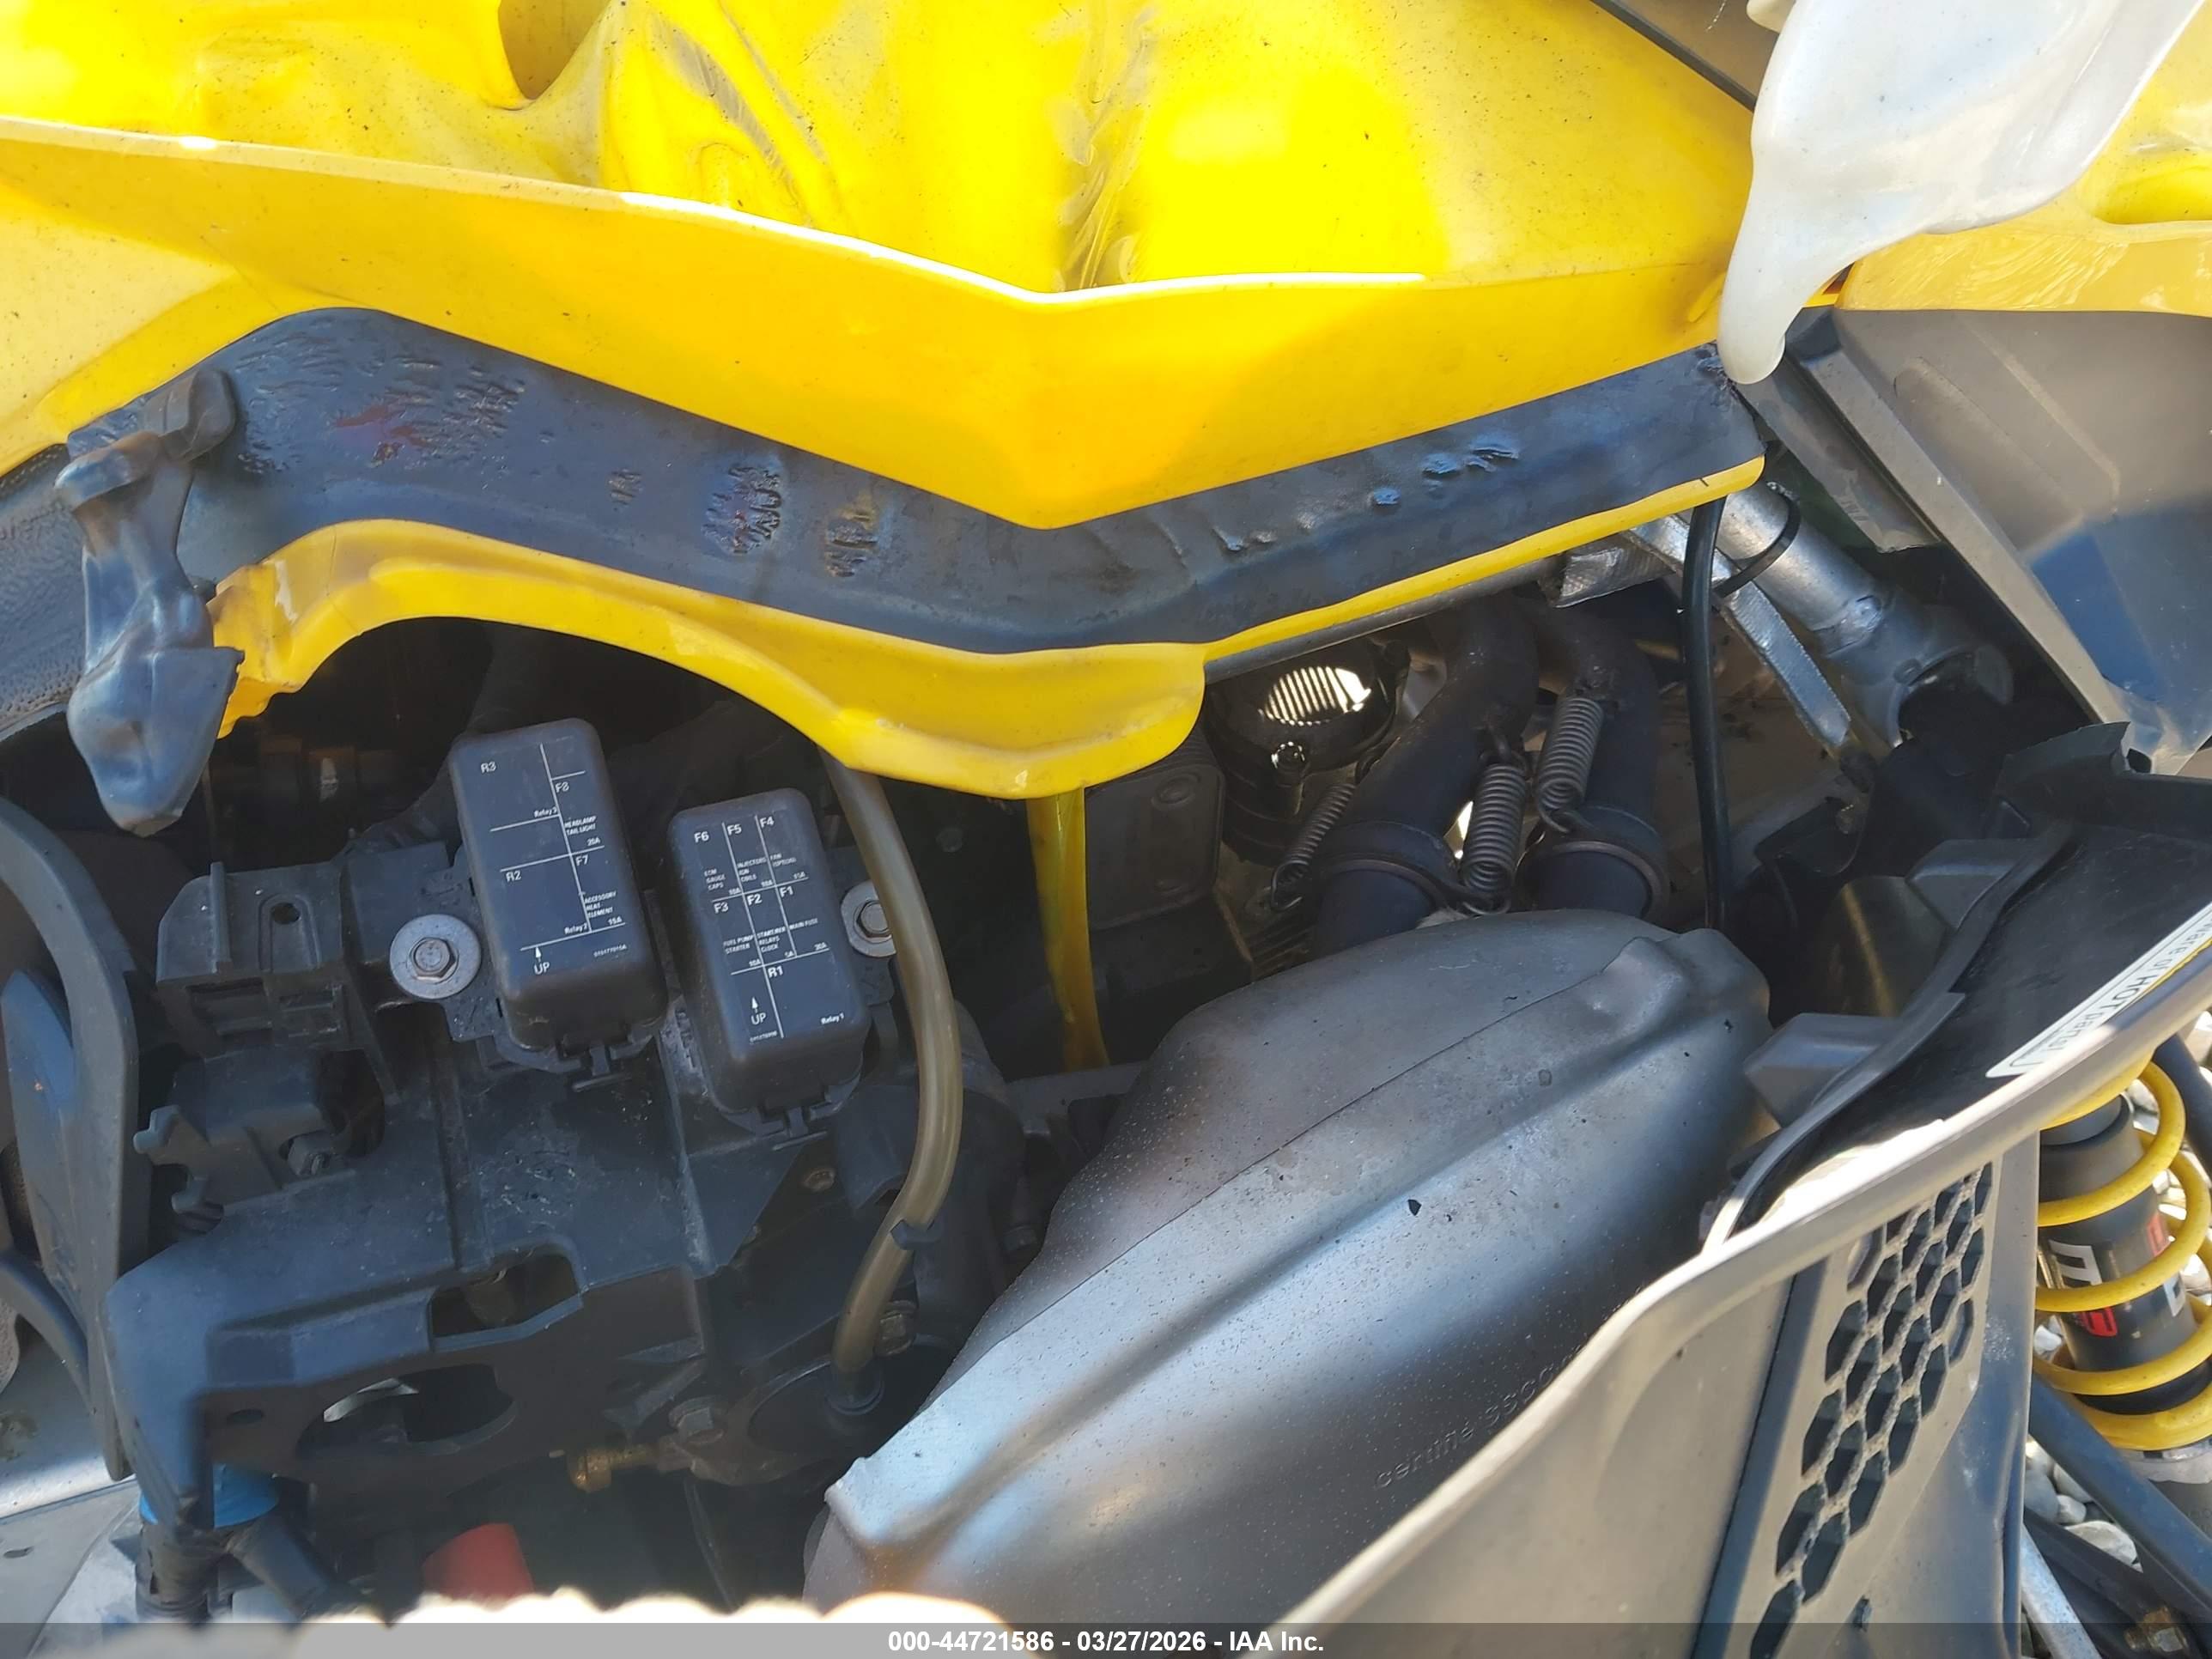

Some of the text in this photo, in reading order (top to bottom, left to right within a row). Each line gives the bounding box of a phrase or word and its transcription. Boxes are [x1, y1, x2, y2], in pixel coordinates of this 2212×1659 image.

[481, 761, 496, 774] R3
[556, 781, 570, 793] F8
[760, 816, 775, 829] F4
[727, 823, 742, 836] F5
[694, 831, 709, 842] F6
[575, 854, 588, 866] F7
[506, 870, 521, 882] R2
[585, 890, 617, 903] ACCESSORY
[780, 886, 793, 898] F1
[747, 894, 762, 906] F2
[587, 906, 613, 918] ELEMENT
[714, 902, 729, 914] F3
[723, 934, 754, 947] FUEL PUMP
[758, 935, 780, 945] RELAYS
[725, 943, 750, 954] STARTER
[534, 961, 550, 975] UP
[768, 965, 783, 977] R1
[2100, 974, 2160, 1013] HOT
[751, 1012, 766, 1025] UP
